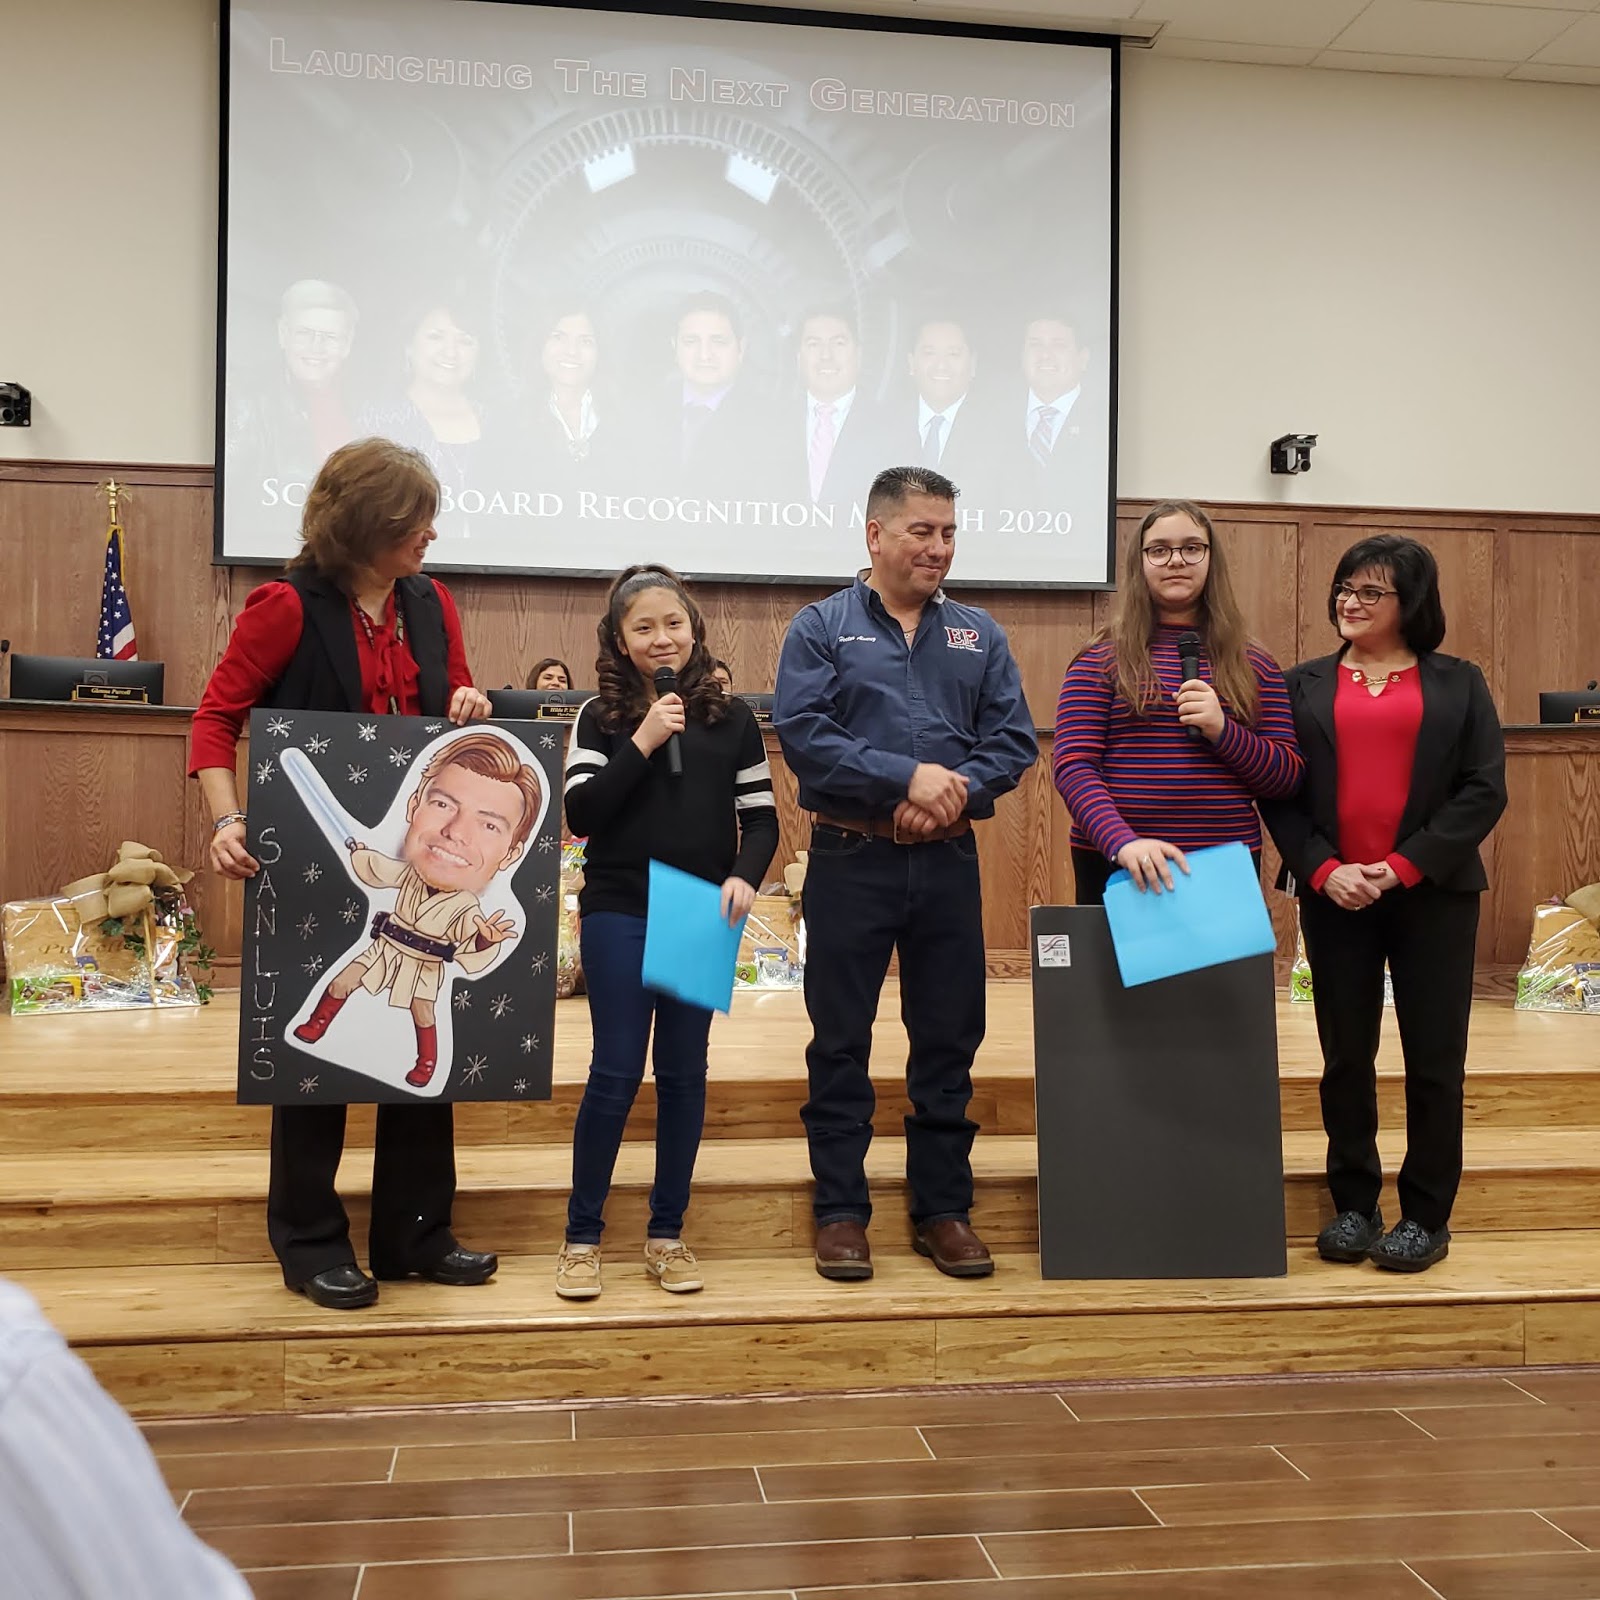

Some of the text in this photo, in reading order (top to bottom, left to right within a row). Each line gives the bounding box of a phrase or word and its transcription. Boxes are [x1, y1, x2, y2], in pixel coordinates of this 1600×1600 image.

[269, 37, 1076, 128] LAUNCHING THE NEXT GENERATION
[438, 485, 563, 518] BOARD
[577, 490, 836, 529] RECOGNITION
[998, 508, 1073, 535] 2020
